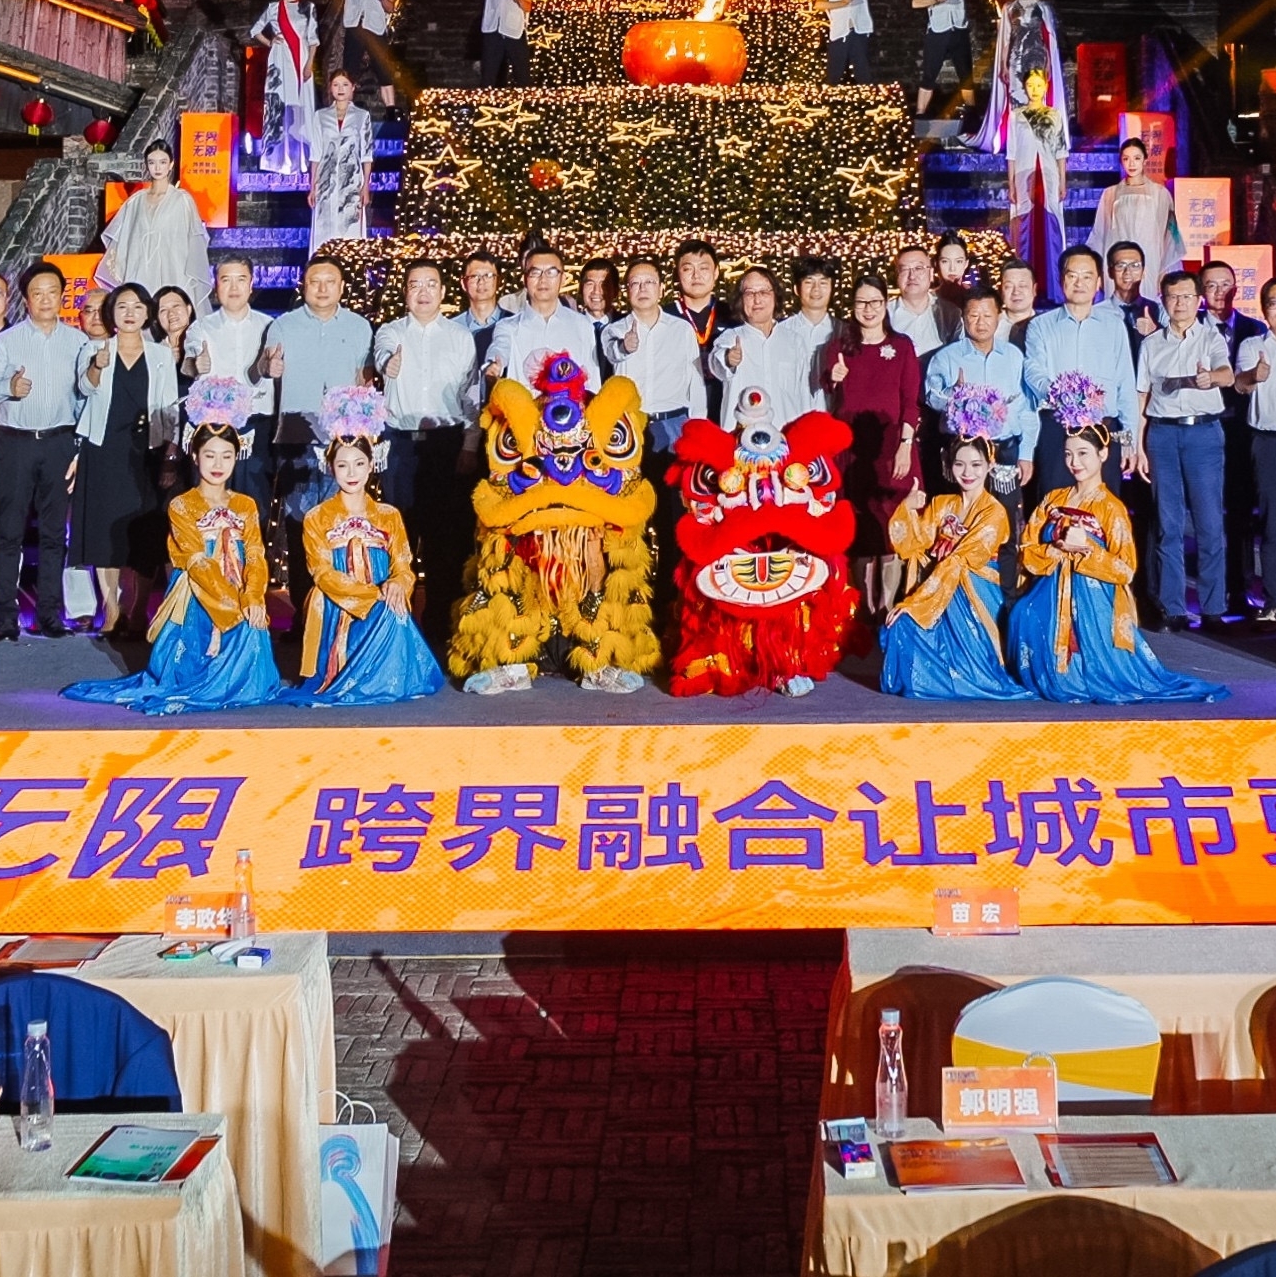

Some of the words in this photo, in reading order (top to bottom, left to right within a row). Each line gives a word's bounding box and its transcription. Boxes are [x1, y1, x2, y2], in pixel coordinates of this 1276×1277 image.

[951, 902, 1000, 924] 苗宏
[959, 1088, 1040, 1116] 郭明强
